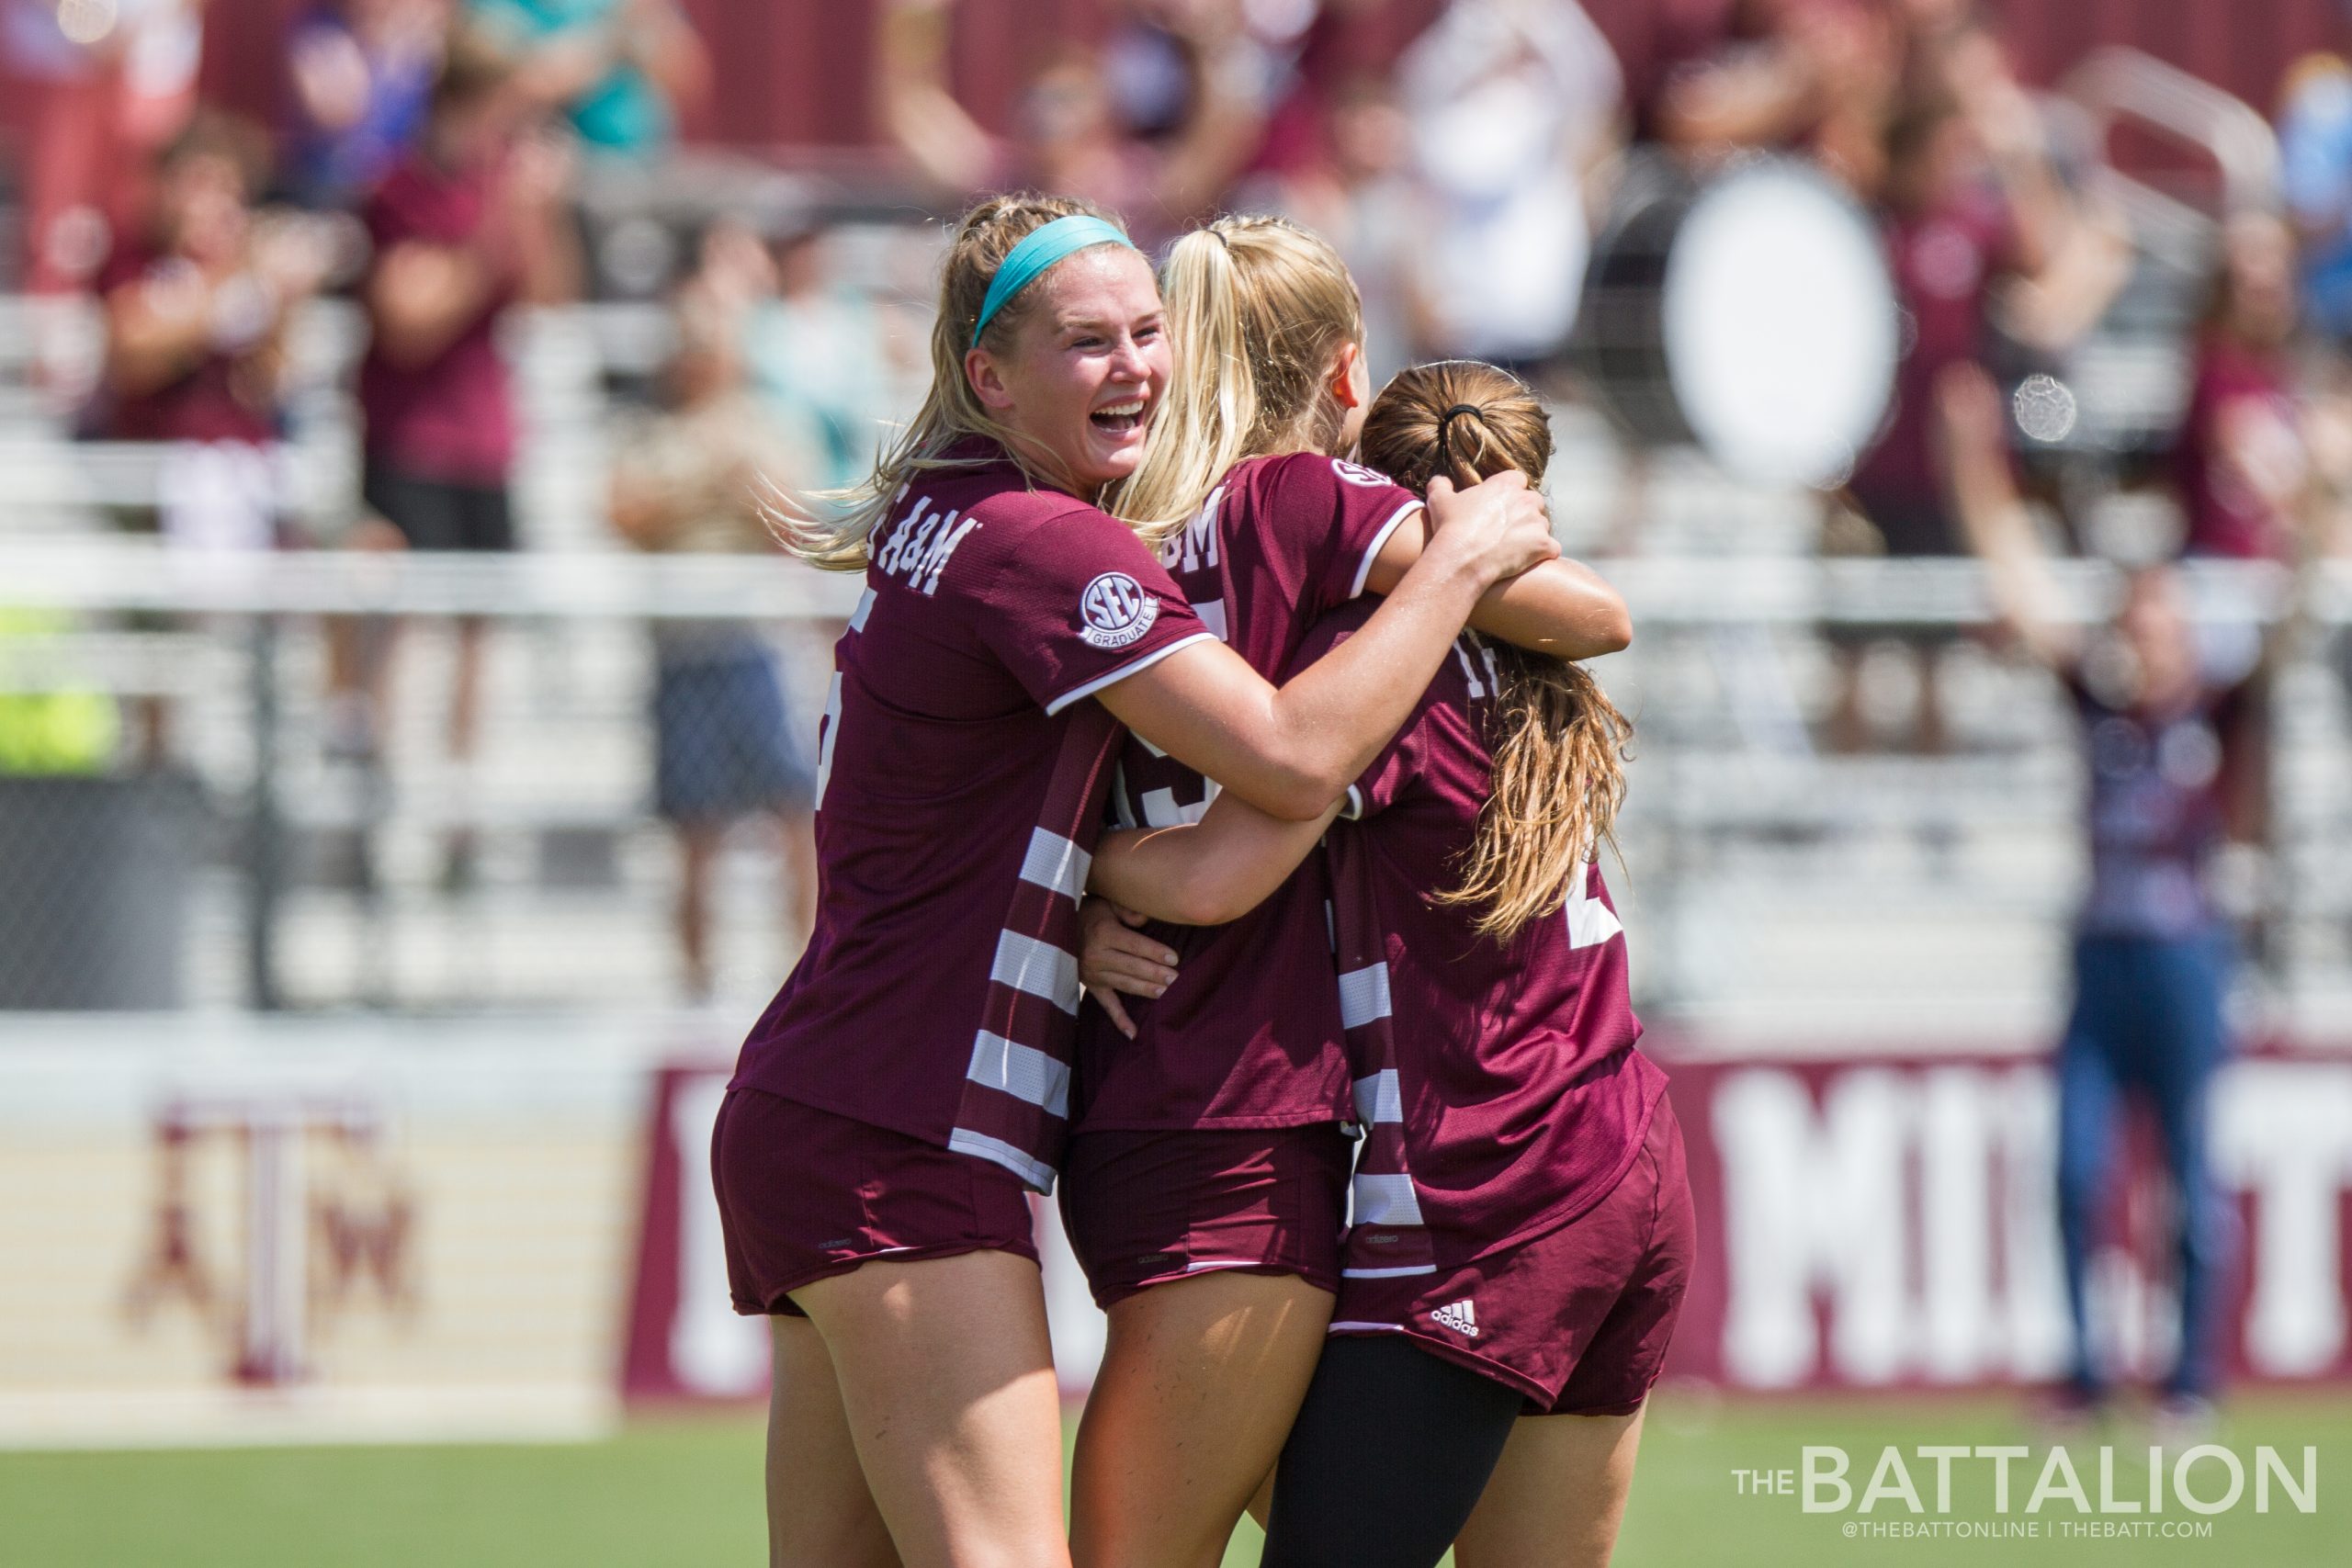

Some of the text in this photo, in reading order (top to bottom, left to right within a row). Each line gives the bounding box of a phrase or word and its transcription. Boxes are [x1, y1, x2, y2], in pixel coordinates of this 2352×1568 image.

[1086, 576, 1140, 629] SEC
[1092, 612, 1154, 646] GRADUATE
[1431, 1310, 1479, 1337] adidas
